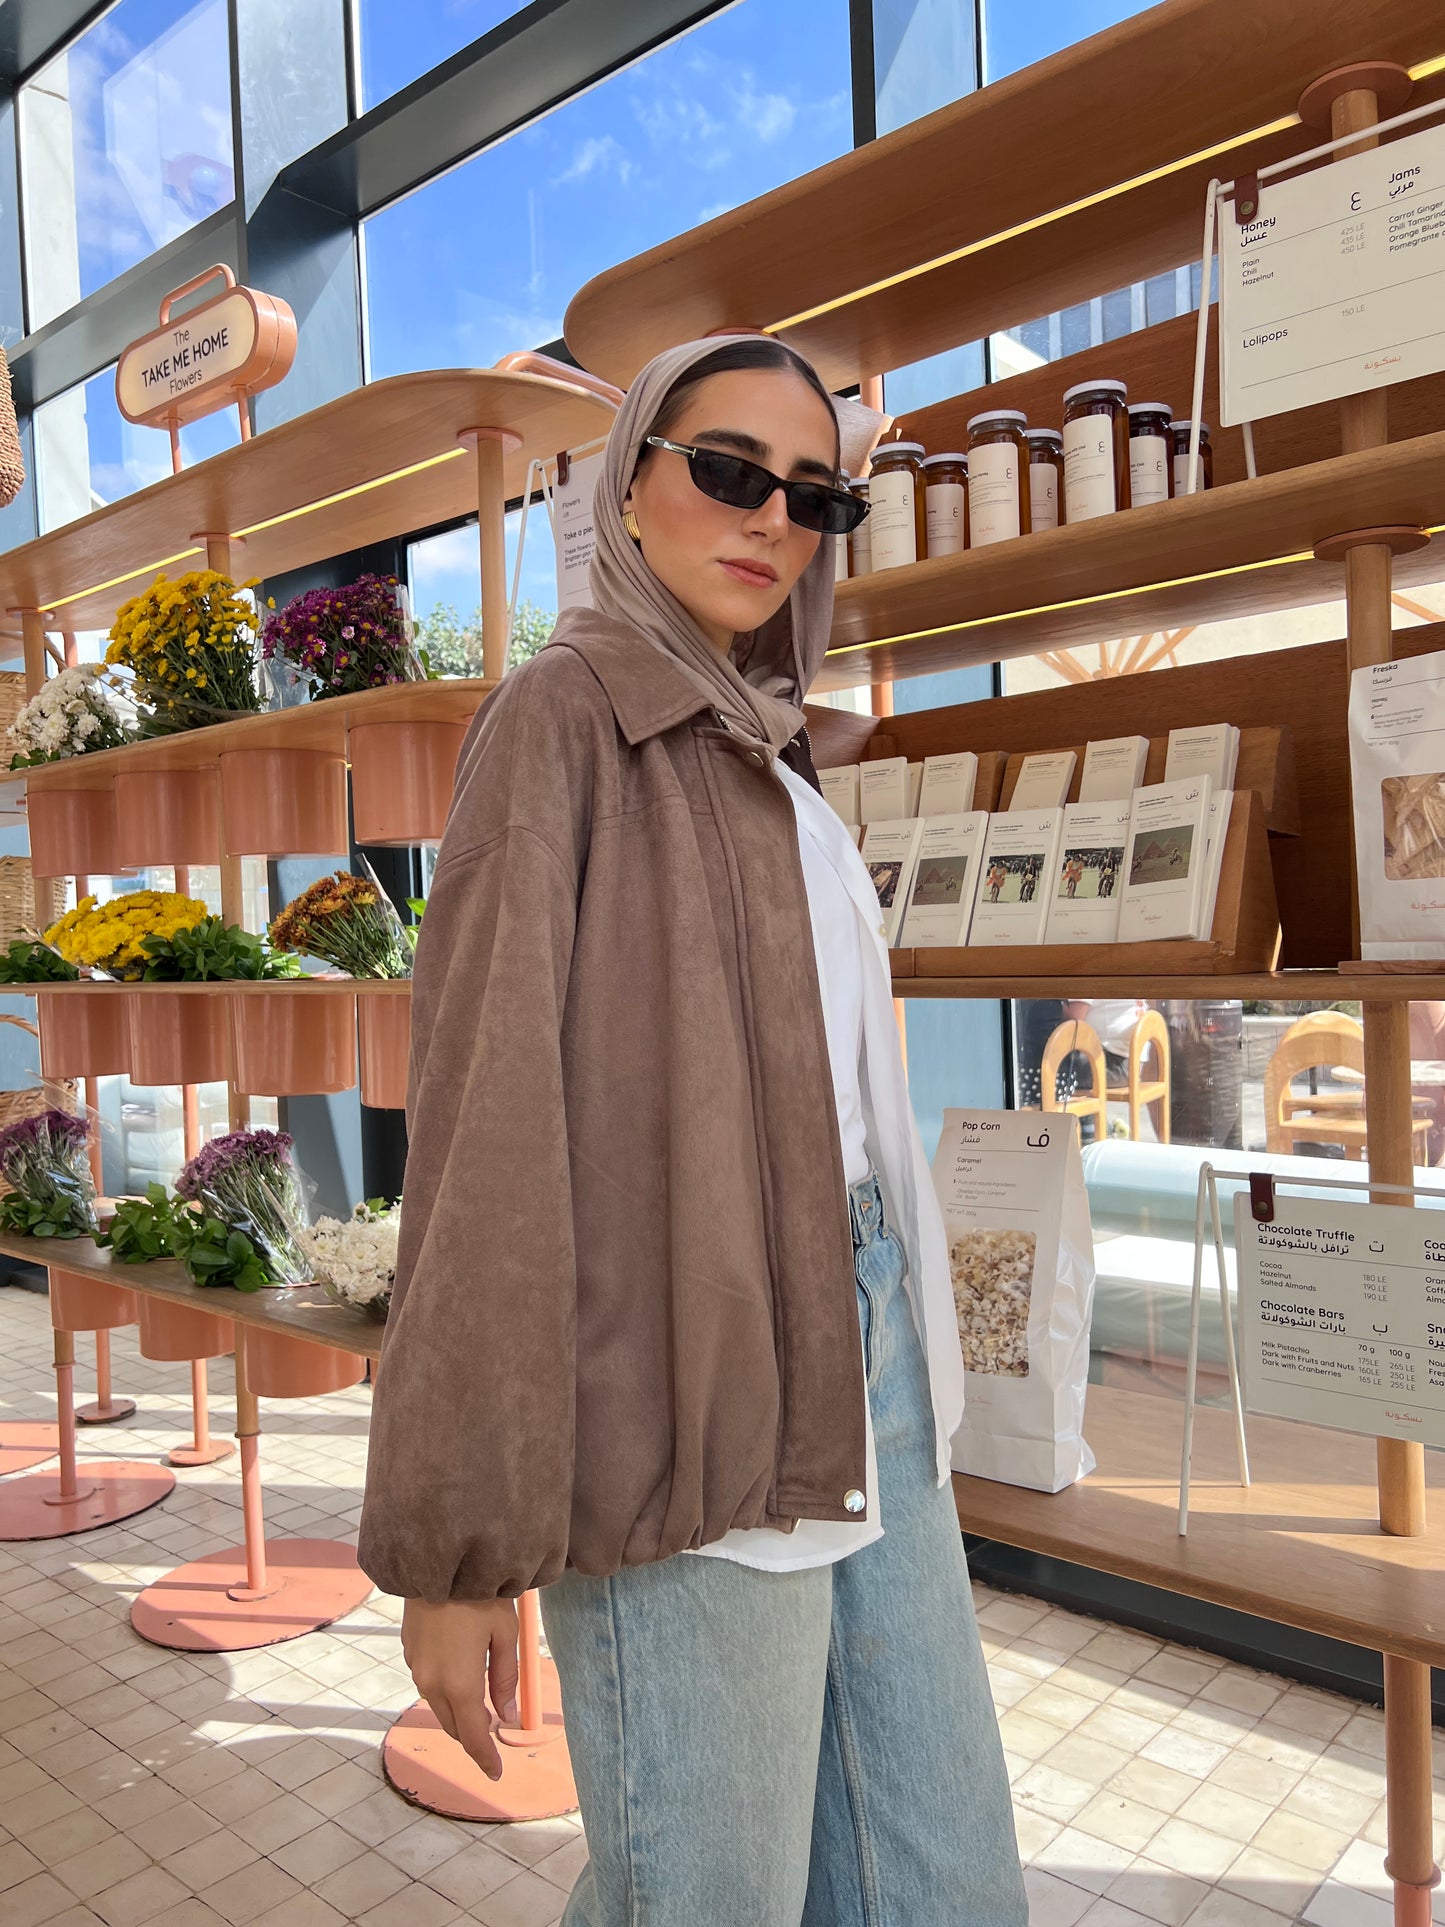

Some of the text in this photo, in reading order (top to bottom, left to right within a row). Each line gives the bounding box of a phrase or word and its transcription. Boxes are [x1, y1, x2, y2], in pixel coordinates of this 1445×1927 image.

[1388, 166, 1421, 184] Jams
[1350, 191, 1362, 211] ع
[1388, 200, 1444, 225] Carrot Ginger
[1241, 217, 1276, 235] Honey
[1355, 222, 1365, 231] LE
[1388, 221, 1406, 234] Chili
[1240, 232, 1268, 248] عسل
[1356, 232, 1365, 241] LE
[1389, 228, 1419, 243] Orange
[1389, 232, 1439, 252] Pomegrante
[1356, 242, 1366, 250] LE
[1242, 258, 1260, 268] Plain
[1242, 271, 1274, 286] Hazelnut
[1341, 304, 1366, 317] 150 LE
[173, 330, 190, 346] The
[1242, 328, 1289, 349] Lolipops
[141, 327, 229, 388] TAKE ME HOME
[169, 369, 203, 395] Flowers
[563, 531, 577, 541] Take
[1372, 664, 1399, 674] Freska
[962, 1121, 1001, 1131] Pop Corn
[960, 1135, 981, 1145] فشار
[1026, 1127, 1050, 1148] ف
[956, 1156, 982, 1165] Caramel
[1257, 1222, 1355, 1242] Chocolate Truffle
[1258, 1235, 1349, 1256] ترافل بالشوكولاتة
[1369, 1240, 1384, 1253] ت
[1259, 1260, 1283, 1270] Cocoa
[1260, 1270, 1292, 1280] Hazelnut
[1362, 1274, 1387, 1283] 180 LE
[1260, 1278, 1316, 1291] Salted Almonds
[1363, 1283, 1388, 1293] 190 LE
[1363, 1293, 1376, 1301] 190
[1260, 1299, 1345, 1320] Chocolate Bars
[1261, 1312, 1346, 1335] بارات الشوكولاتة
[1372, 1324, 1388, 1337] ب
[1261, 1341, 1310, 1355] Milk Pistachio
[1358, 1344, 1375, 1354] 70 g
[1389, 1349, 1411, 1360] 100 g
[1261, 1349, 1355, 1371] Dark with Fruits and Nuts
[1262, 1358, 1342, 1378] Dark with Cranberries
[1390, 1362, 1415, 1372] 265 LE
[1359, 1375, 1382, 1386] 165 LE
[1390, 1371, 1404, 1381] 250
[1390, 1381, 1416, 1392] 255 LE
